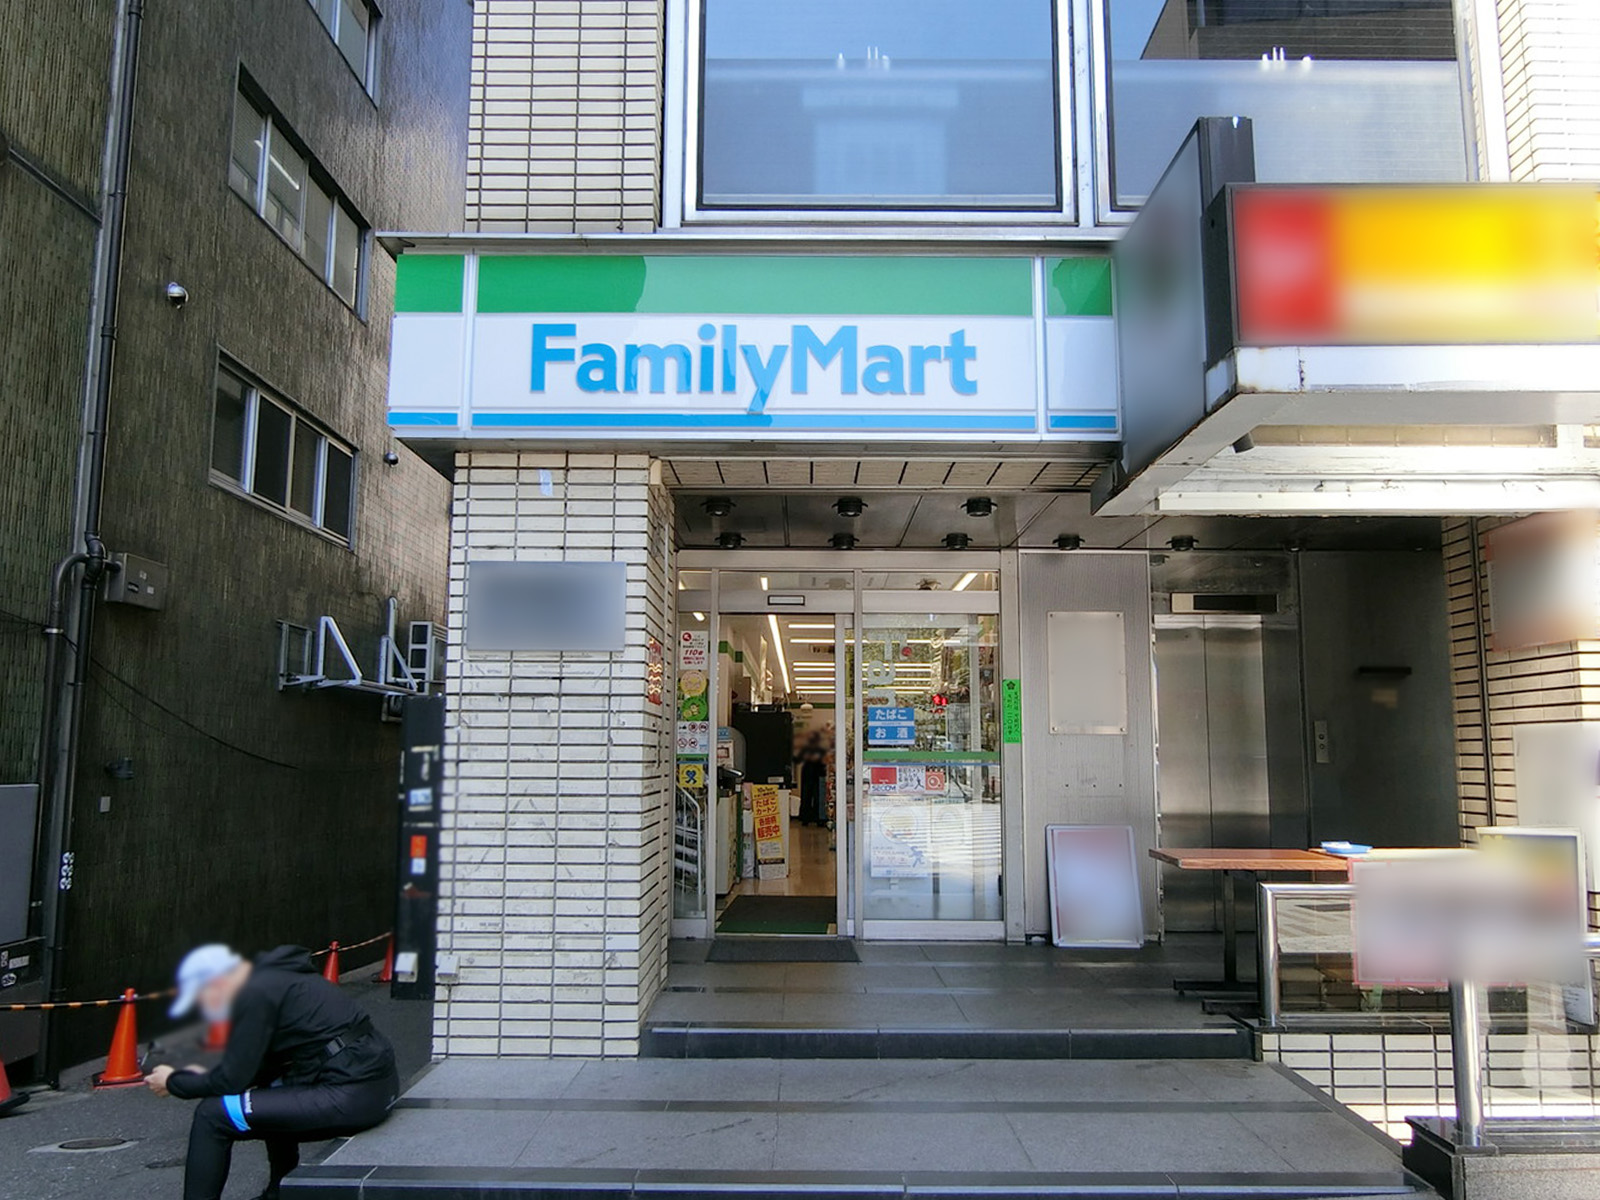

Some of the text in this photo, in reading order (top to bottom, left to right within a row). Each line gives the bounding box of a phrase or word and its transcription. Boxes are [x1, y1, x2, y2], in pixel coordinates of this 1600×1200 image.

[530, 323, 978, 414] FamilyMart
[875, 708, 907, 720] たばこ
